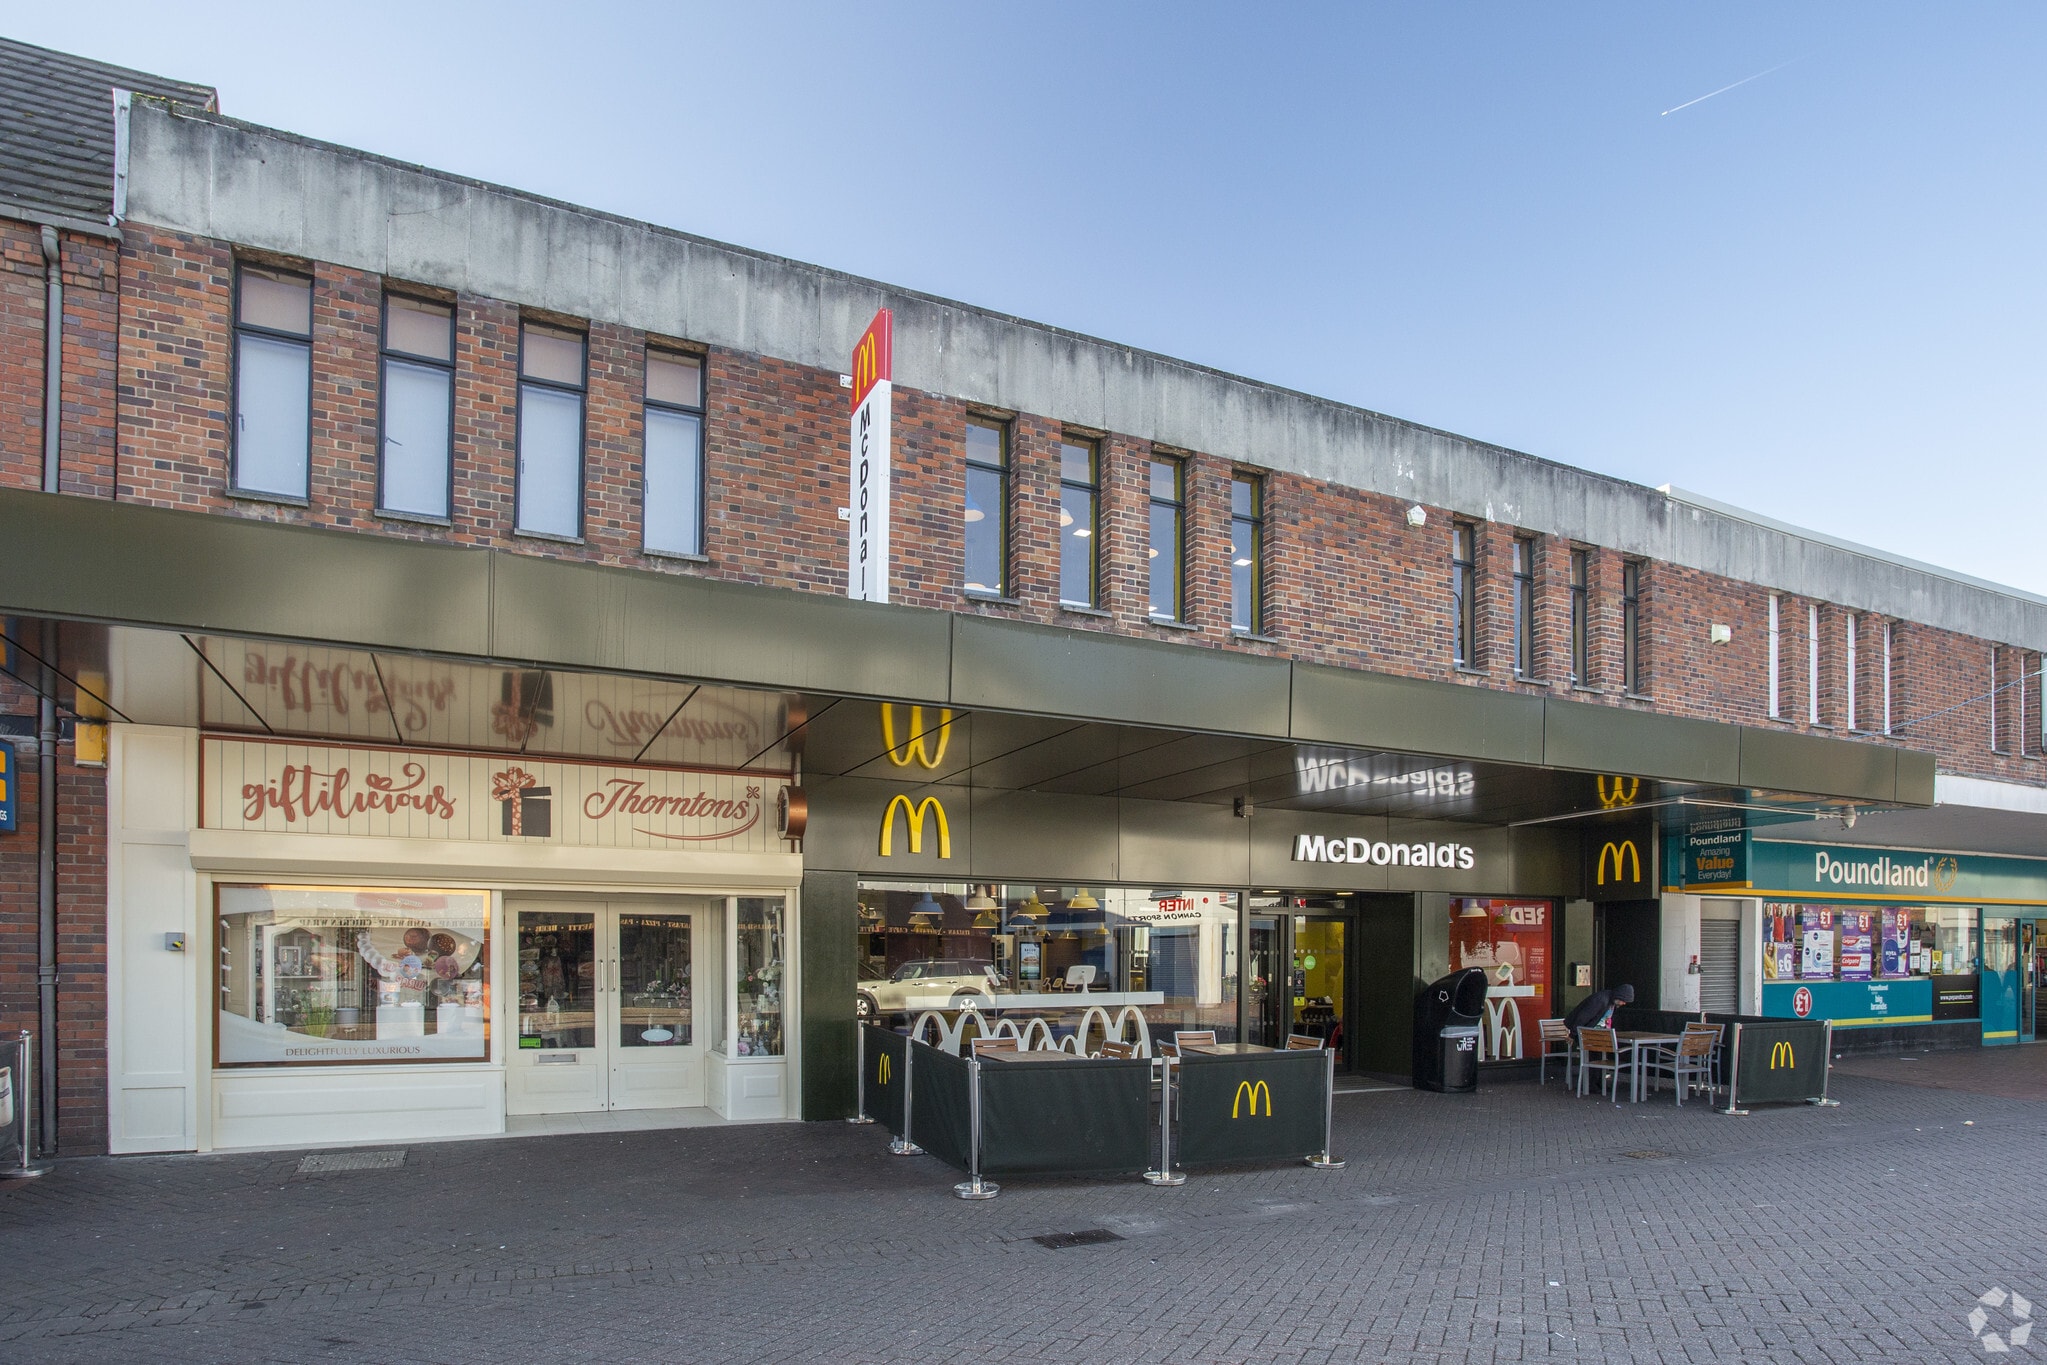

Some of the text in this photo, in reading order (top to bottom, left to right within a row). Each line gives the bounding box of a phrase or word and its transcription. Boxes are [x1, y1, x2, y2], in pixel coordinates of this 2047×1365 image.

[242, 762, 457, 822] giftilicious
[584, 778, 750, 820] Thorntons
[1690, 833, 1742, 846] Poundland
[1294, 834, 1475, 869] McDonald's
[1700, 847, 1730, 856] Amazing
[1696, 856, 1735, 870] Value
[1815, 851, 1929, 888] Poundland
[1698, 869, 1732, 880] Everyday!
[1820, 911, 1831, 925] £1
[1858, 914, 1869, 928] £1
[1897, 913, 1907, 926] £1
[1778, 953, 1792, 973] £6
[1842, 957, 1859, 966] Colgate
[1795, 993, 1809, 1012] £1
[285, 1046, 421, 1057] DELIGHTFULLY LUXURIOUS
